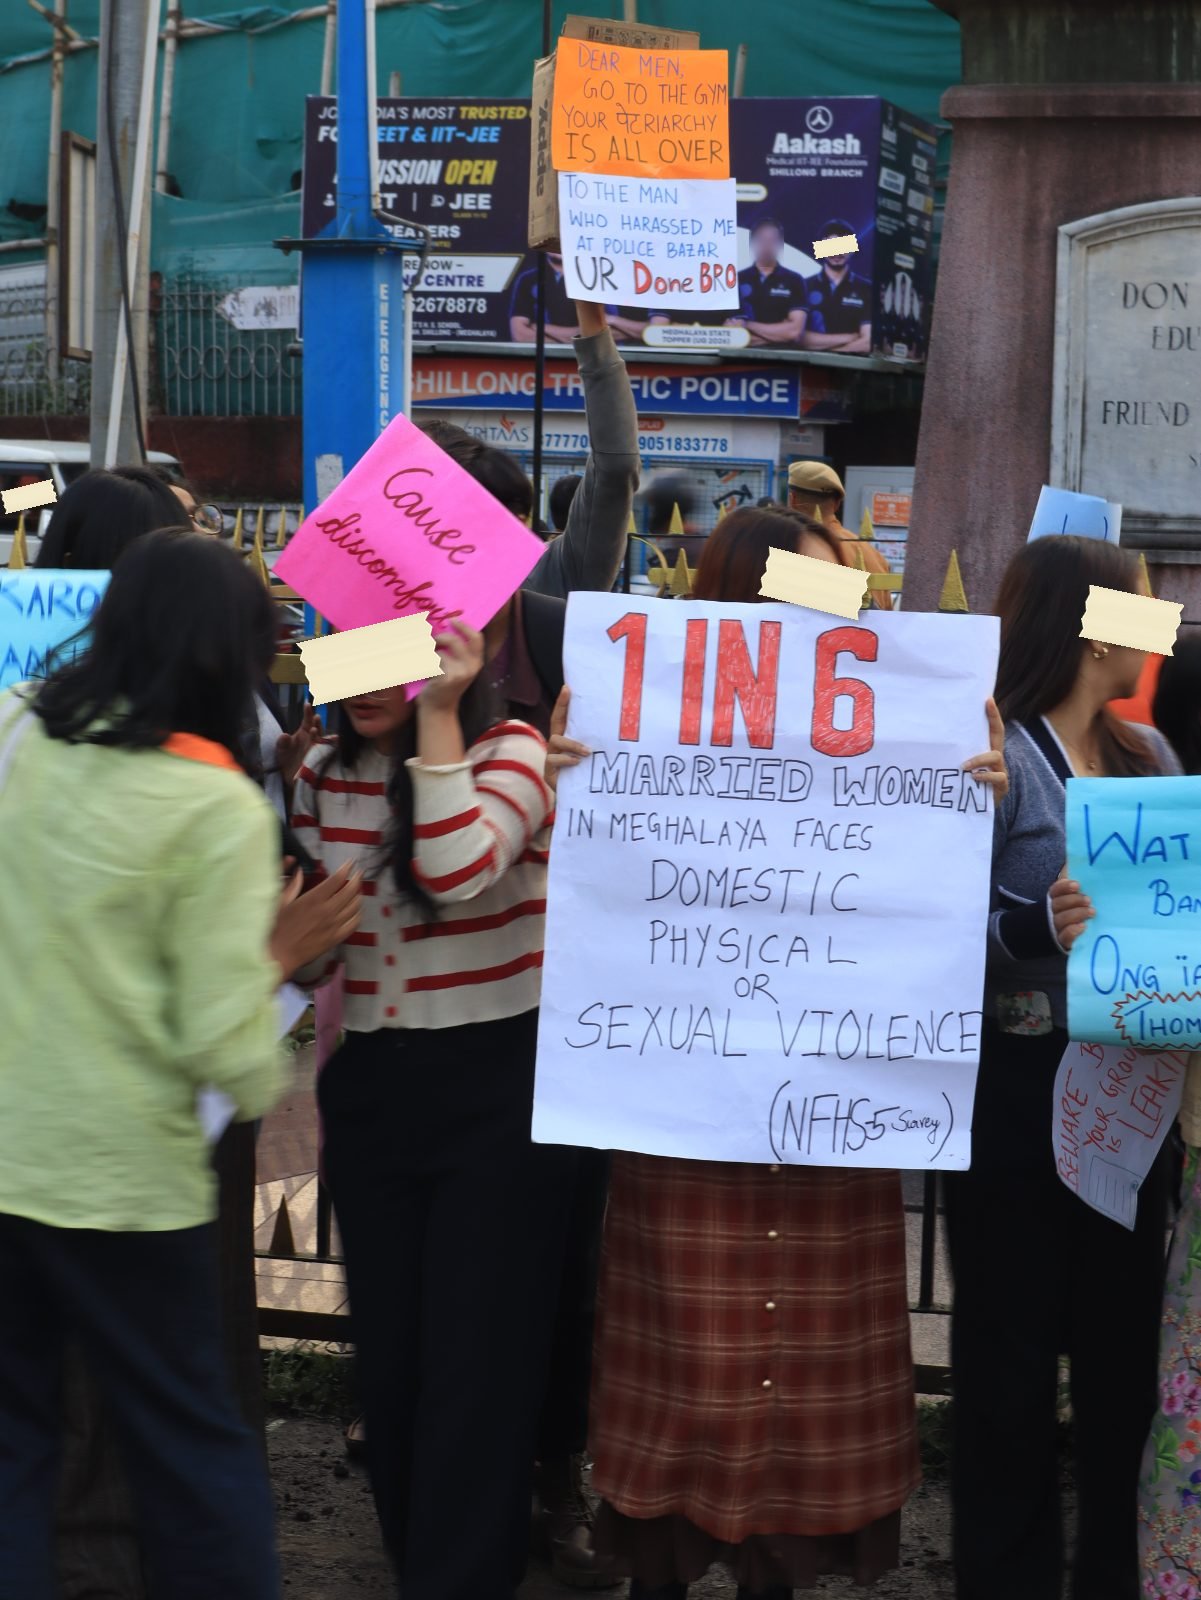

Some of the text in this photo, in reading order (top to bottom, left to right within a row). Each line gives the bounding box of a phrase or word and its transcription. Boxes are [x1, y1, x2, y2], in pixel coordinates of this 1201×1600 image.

[578, 43, 684, 79] DEAR MEN,
[584, 77, 727, 105] GO TO THE GYM
[412, 106, 455, 119] MOST
[459, 106, 526, 119] TRUSTED
[562, 104, 608, 130] YOUR
[377, 126, 409, 143] EET
[411, 126, 427, 143] &
[565, 132, 724, 164] IS ALL OVER
[773, 132, 861, 155] Aakash
[444, 159, 497, 185] OPEN
[769, 167, 863, 178] SHILLONG BRANCH
[449, 193, 492, 210] JEE
[564, 174, 678, 204] TO THE MAN
[569, 209, 736, 237] WHO HARASSED ME
[576, 235, 719, 259] AT POLICE BAZAR
[425, 274, 485, 287] CENTRE
[575, 256, 736, 295] UR Done BRO
[1123, 281, 1188, 310] DON
[379, 284, 389, 431] EMERGENC
[680, 377, 789, 403] POLICE
[1102, 401, 1190, 426] FRIEND
[638, 436, 728, 453] 9051833778
[383, 468, 476, 565] Cause
[606, 611, 878, 757] 1 IN 6
[589, 750, 988, 814] MARRIED WOMEN
[567, 808, 874, 852] IN MEGHALAYA FACES
[1084, 802, 1190, 866] WAT
[645, 859, 860, 915] DOMESTIC
[649, 920, 858, 968] PHYSICAL
[735, 974, 779, 1004] OR
[565, 1002, 984, 1061] SEXUAL VIOLENCE
[1082, 1048, 1139, 1152] YOUR GROU
[1056, 1067, 1089, 1193] BEWARE
[1105, 1136, 1122, 1153] IS
